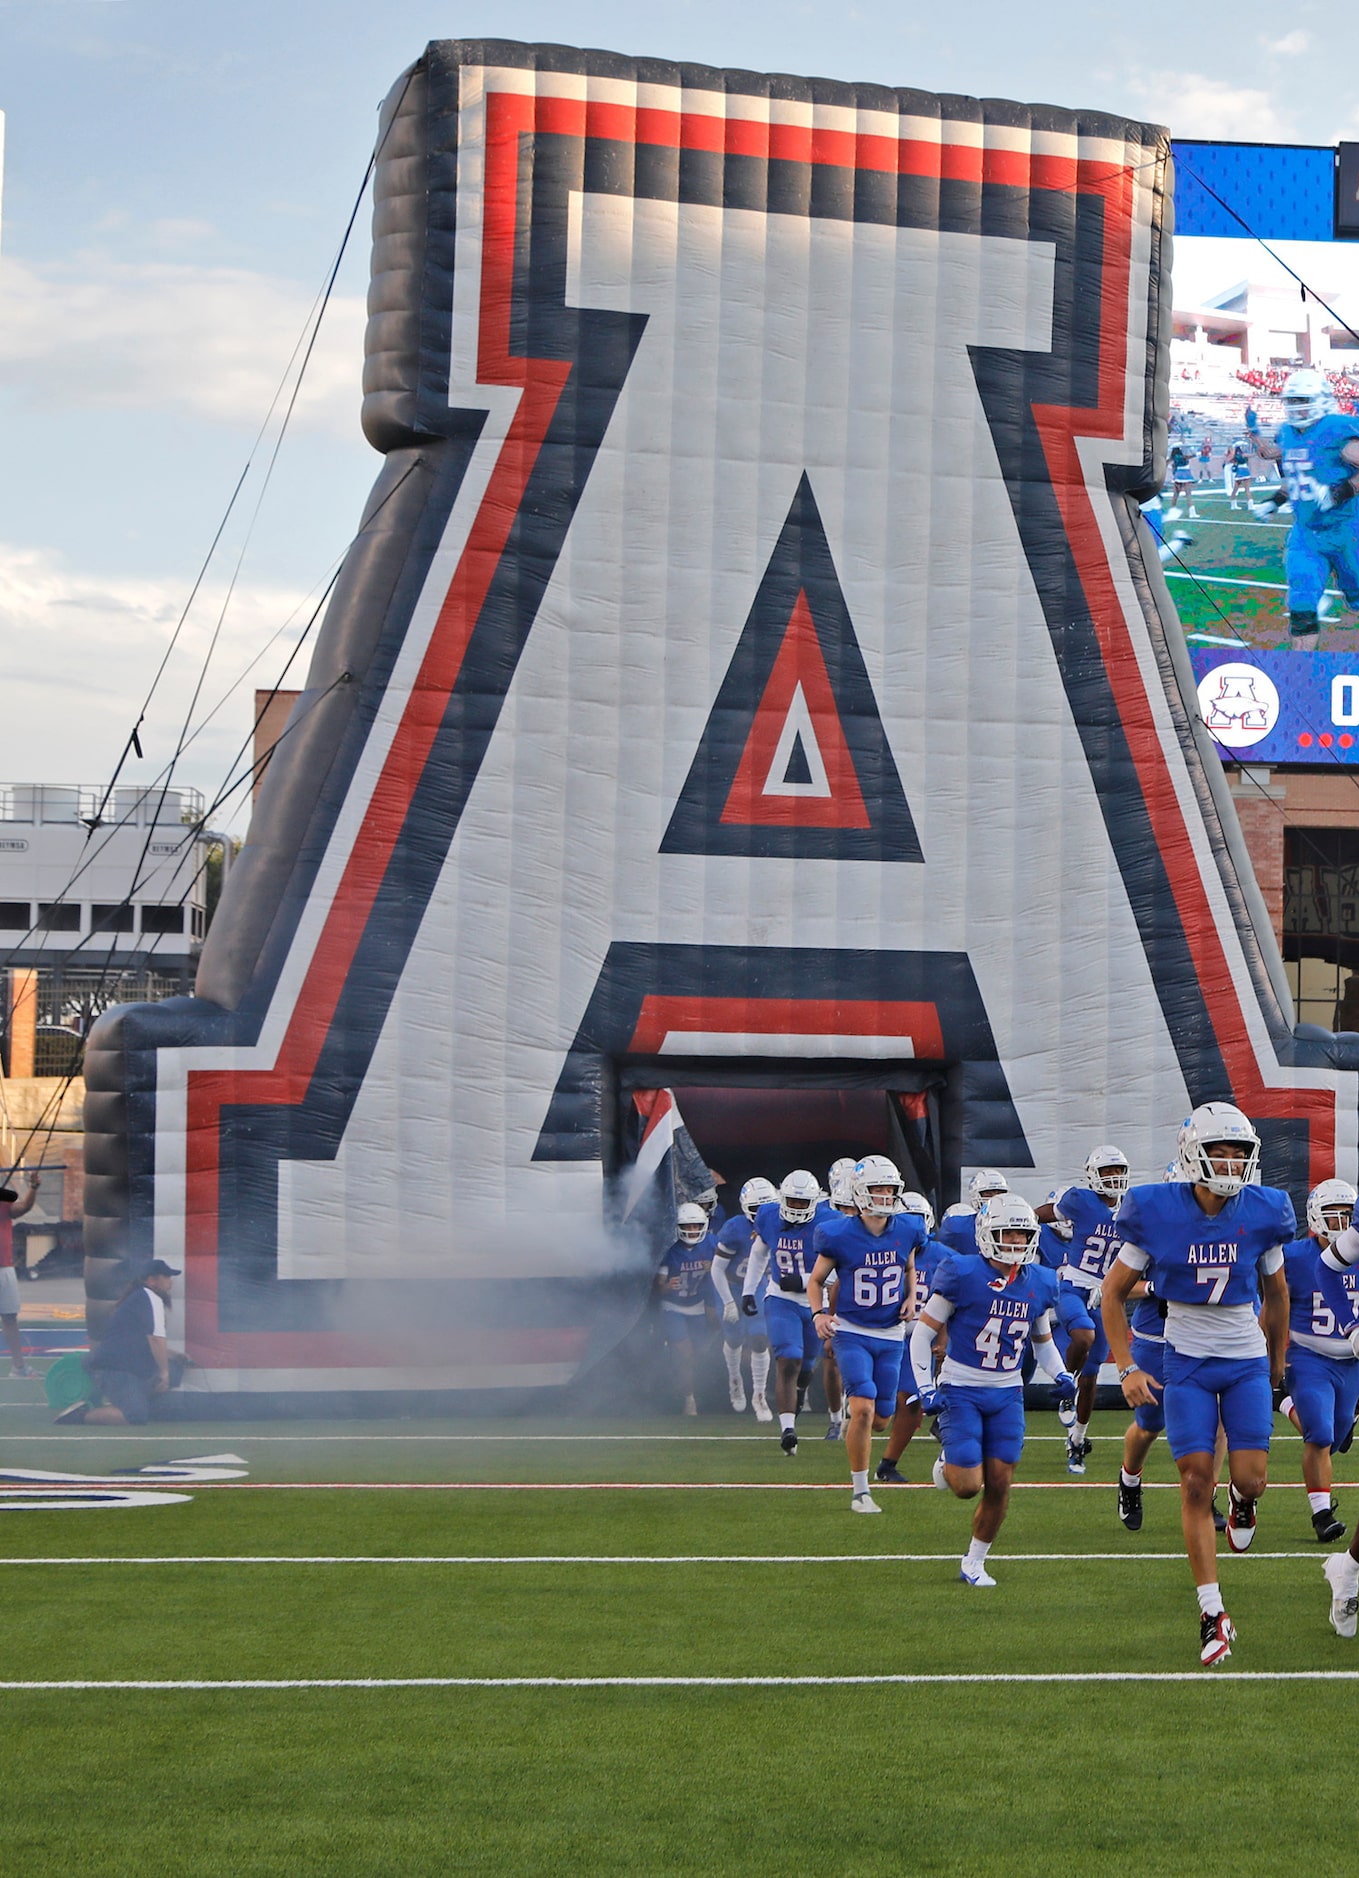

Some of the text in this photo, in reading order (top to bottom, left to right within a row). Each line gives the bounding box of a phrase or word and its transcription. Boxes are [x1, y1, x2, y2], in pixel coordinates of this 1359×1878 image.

[1094, 1223, 1120, 1239] ALLE
[777, 1237, 803, 1251] ALLEN
[1187, 1243, 1238, 1265] ALLEN
[775, 1250, 806, 1279] 91
[864, 1250, 896, 1266] ALLEN
[853, 1264, 903, 1308] 62
[1196, 1265, 1231, 1305] 7
[989, 1300, 1029, 1319] ALLEN
[975, 1318, 1031, 1370] 43
